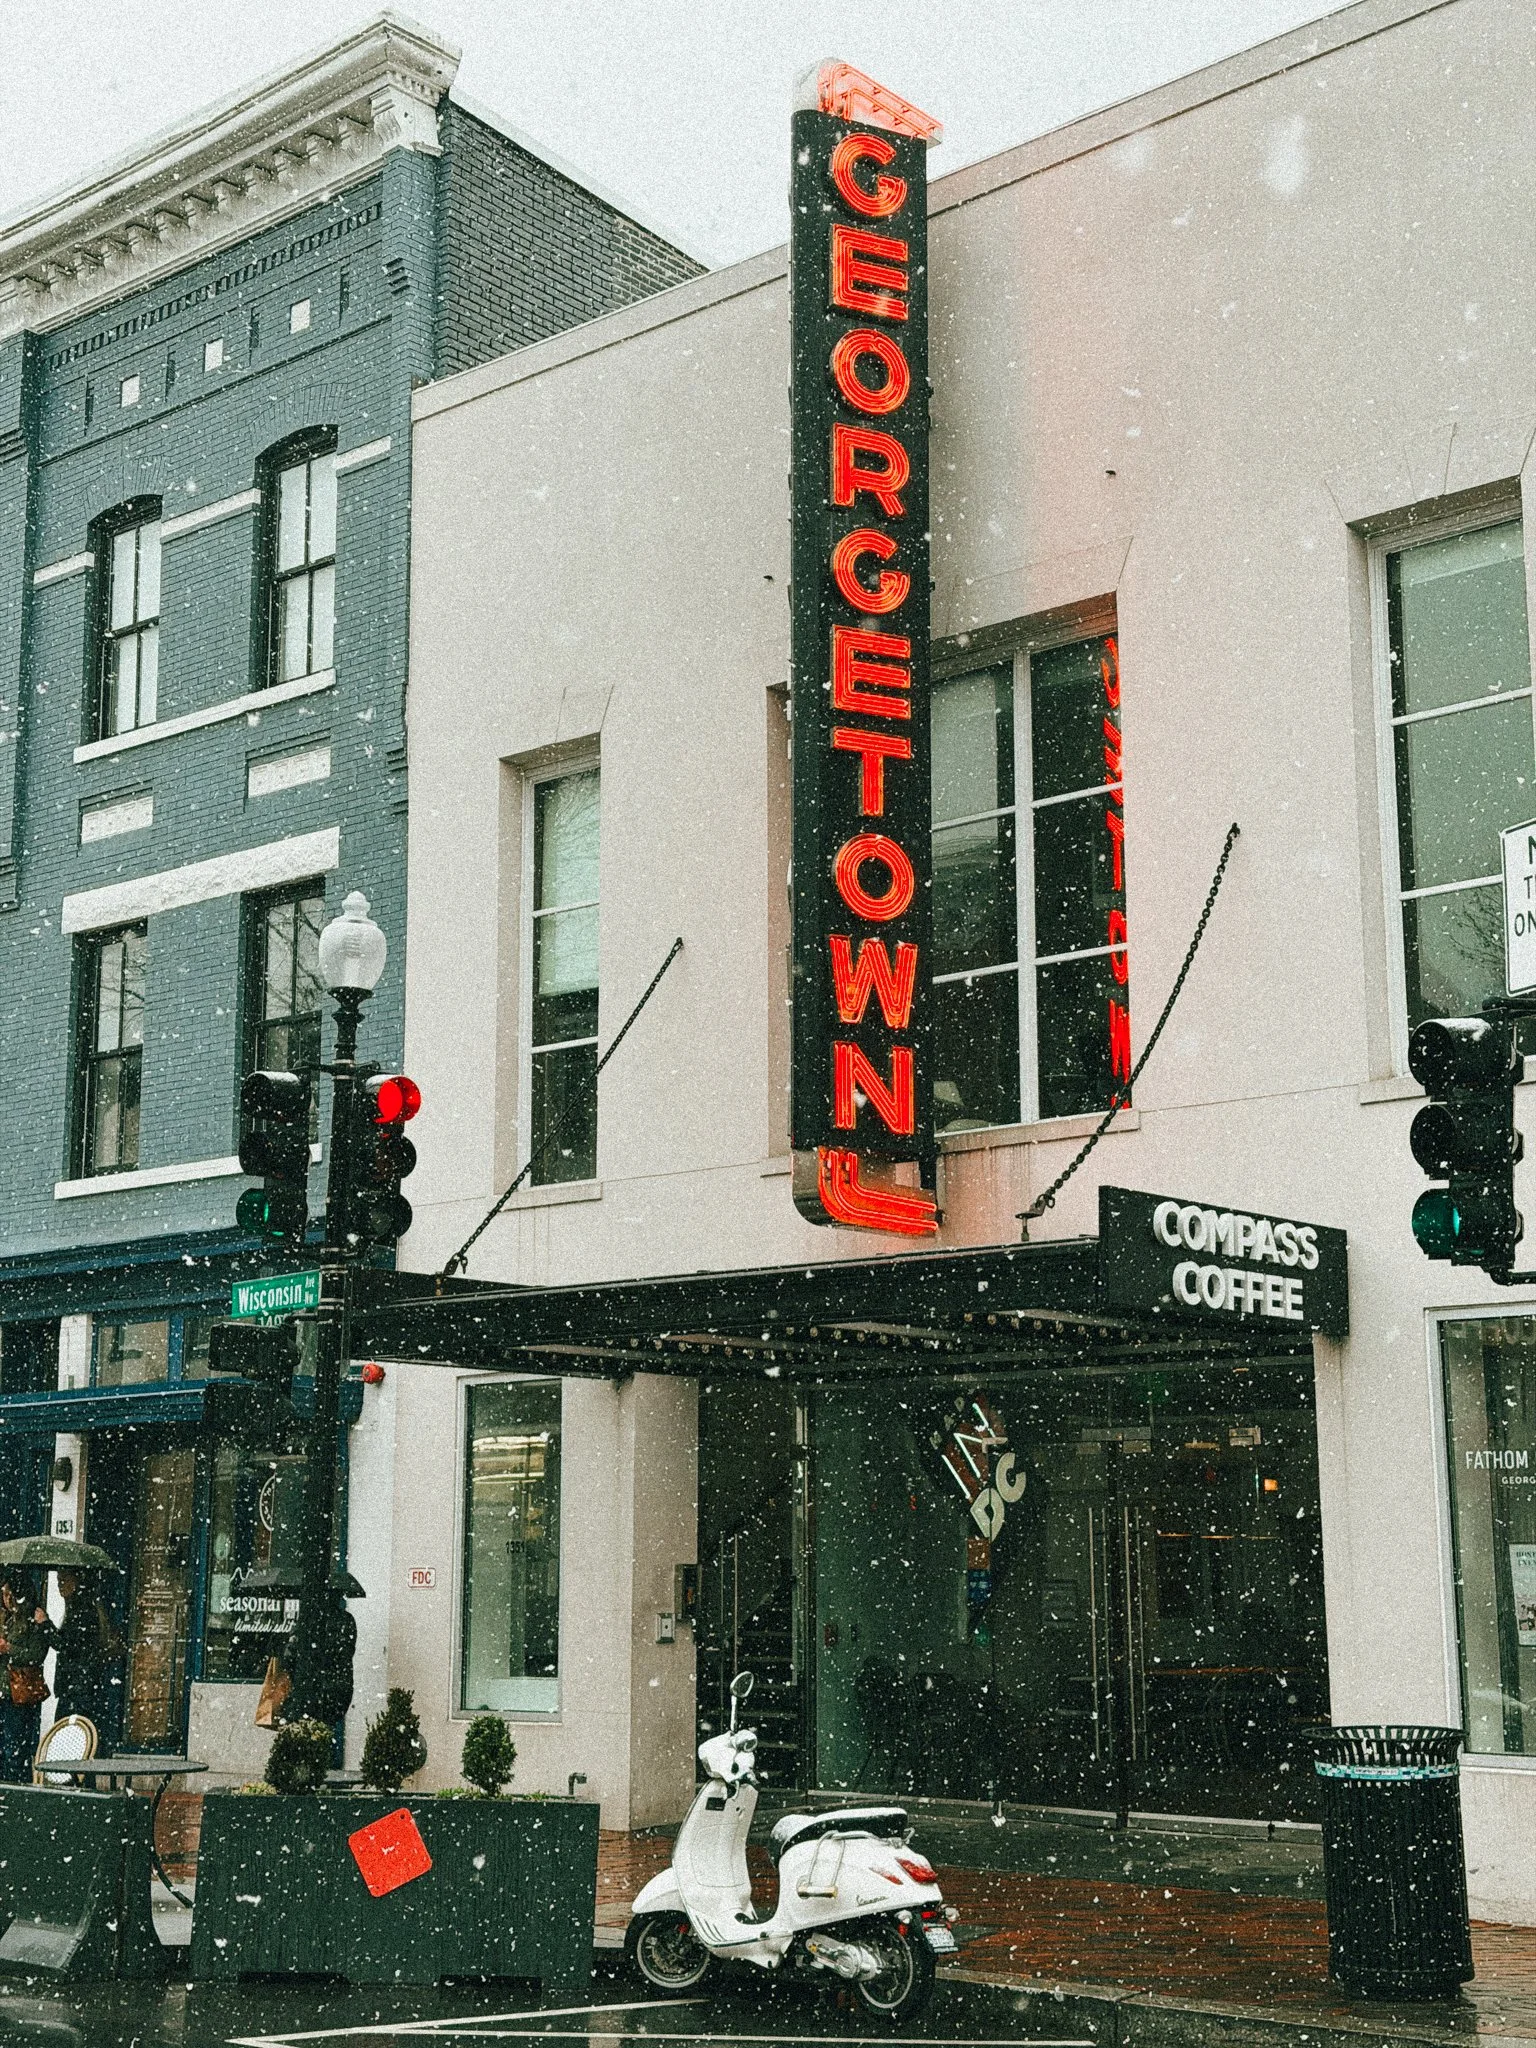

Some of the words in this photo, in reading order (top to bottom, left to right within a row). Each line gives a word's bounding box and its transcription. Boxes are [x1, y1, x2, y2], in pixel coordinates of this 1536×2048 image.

[829, 132, 914, 1135] GEORGETOWN
[1153, 1201, 1319, 1270] COMPASS
[238, 1284, 302, 1313] Wisconsin
[1172, 1261, 1303, 1321] COFFEE
[1465, 1450, 1529, 1469] FATHOM
[412, 1571, 431, 1584] FDC
[235, 1618, 271, 1632] limited
